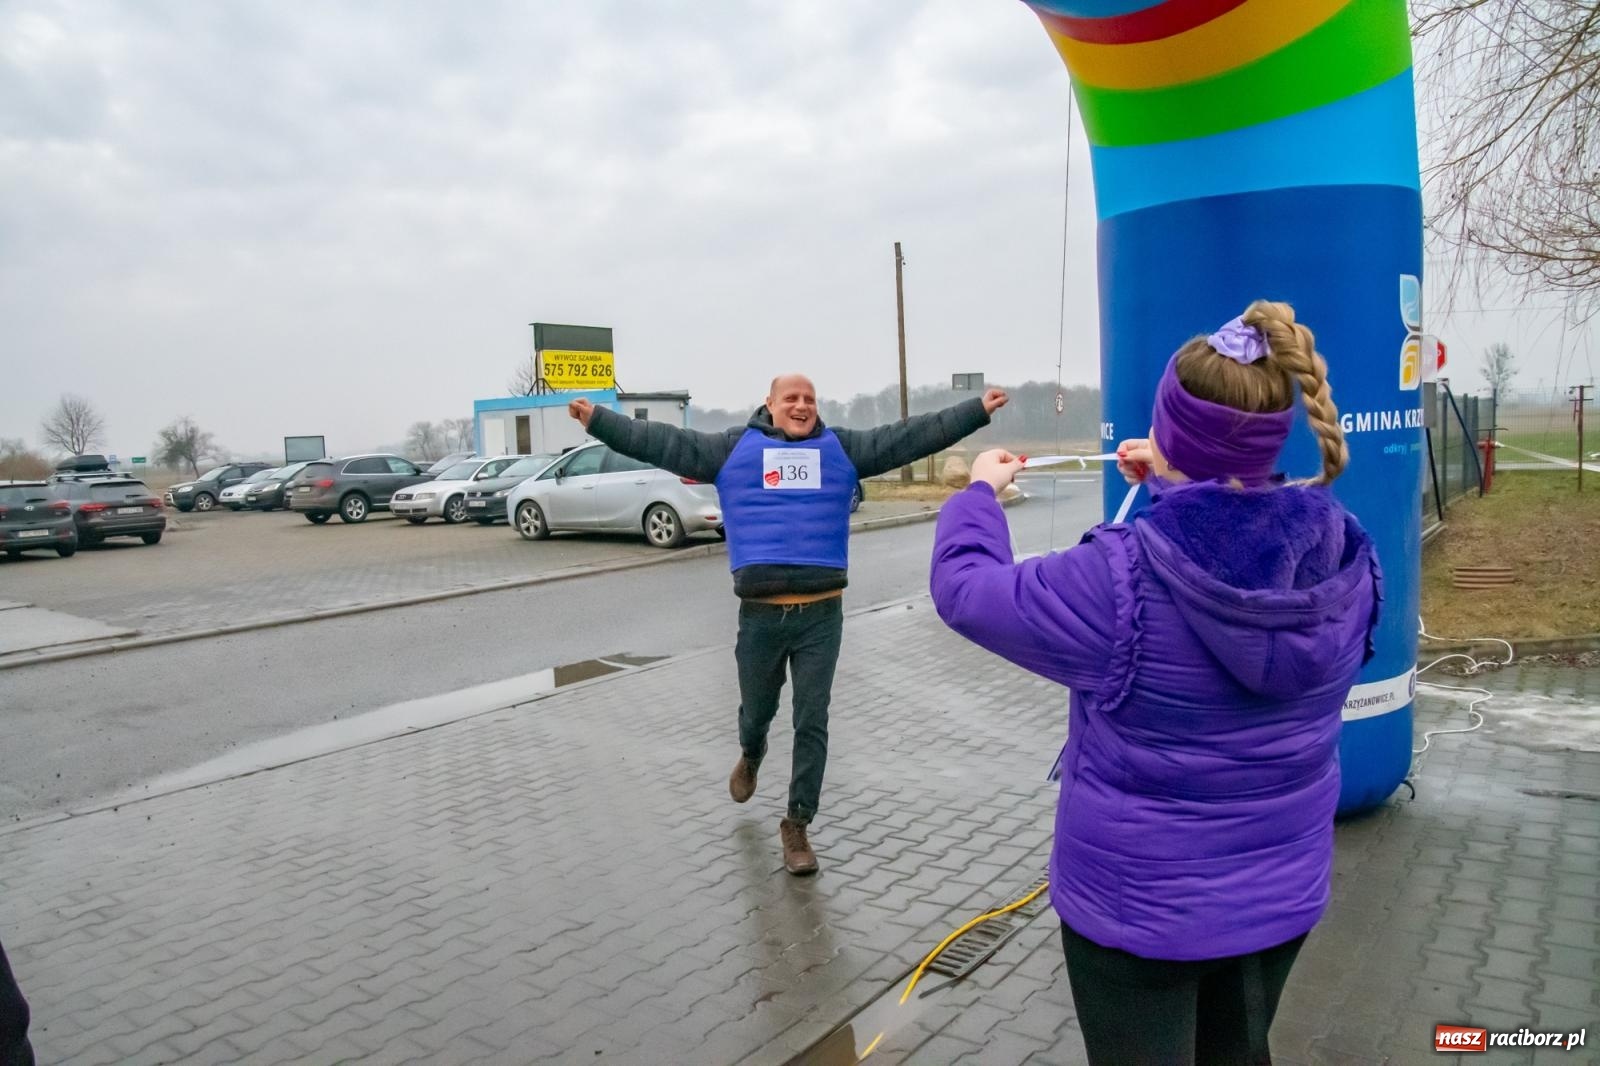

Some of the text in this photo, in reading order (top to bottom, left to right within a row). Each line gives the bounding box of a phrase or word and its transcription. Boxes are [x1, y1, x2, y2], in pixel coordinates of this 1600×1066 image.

[544, 363, 612, 377] 575 792 626
[1340, 410, 1402, 433] GMINA
[778, 464, 808, 481] 136
